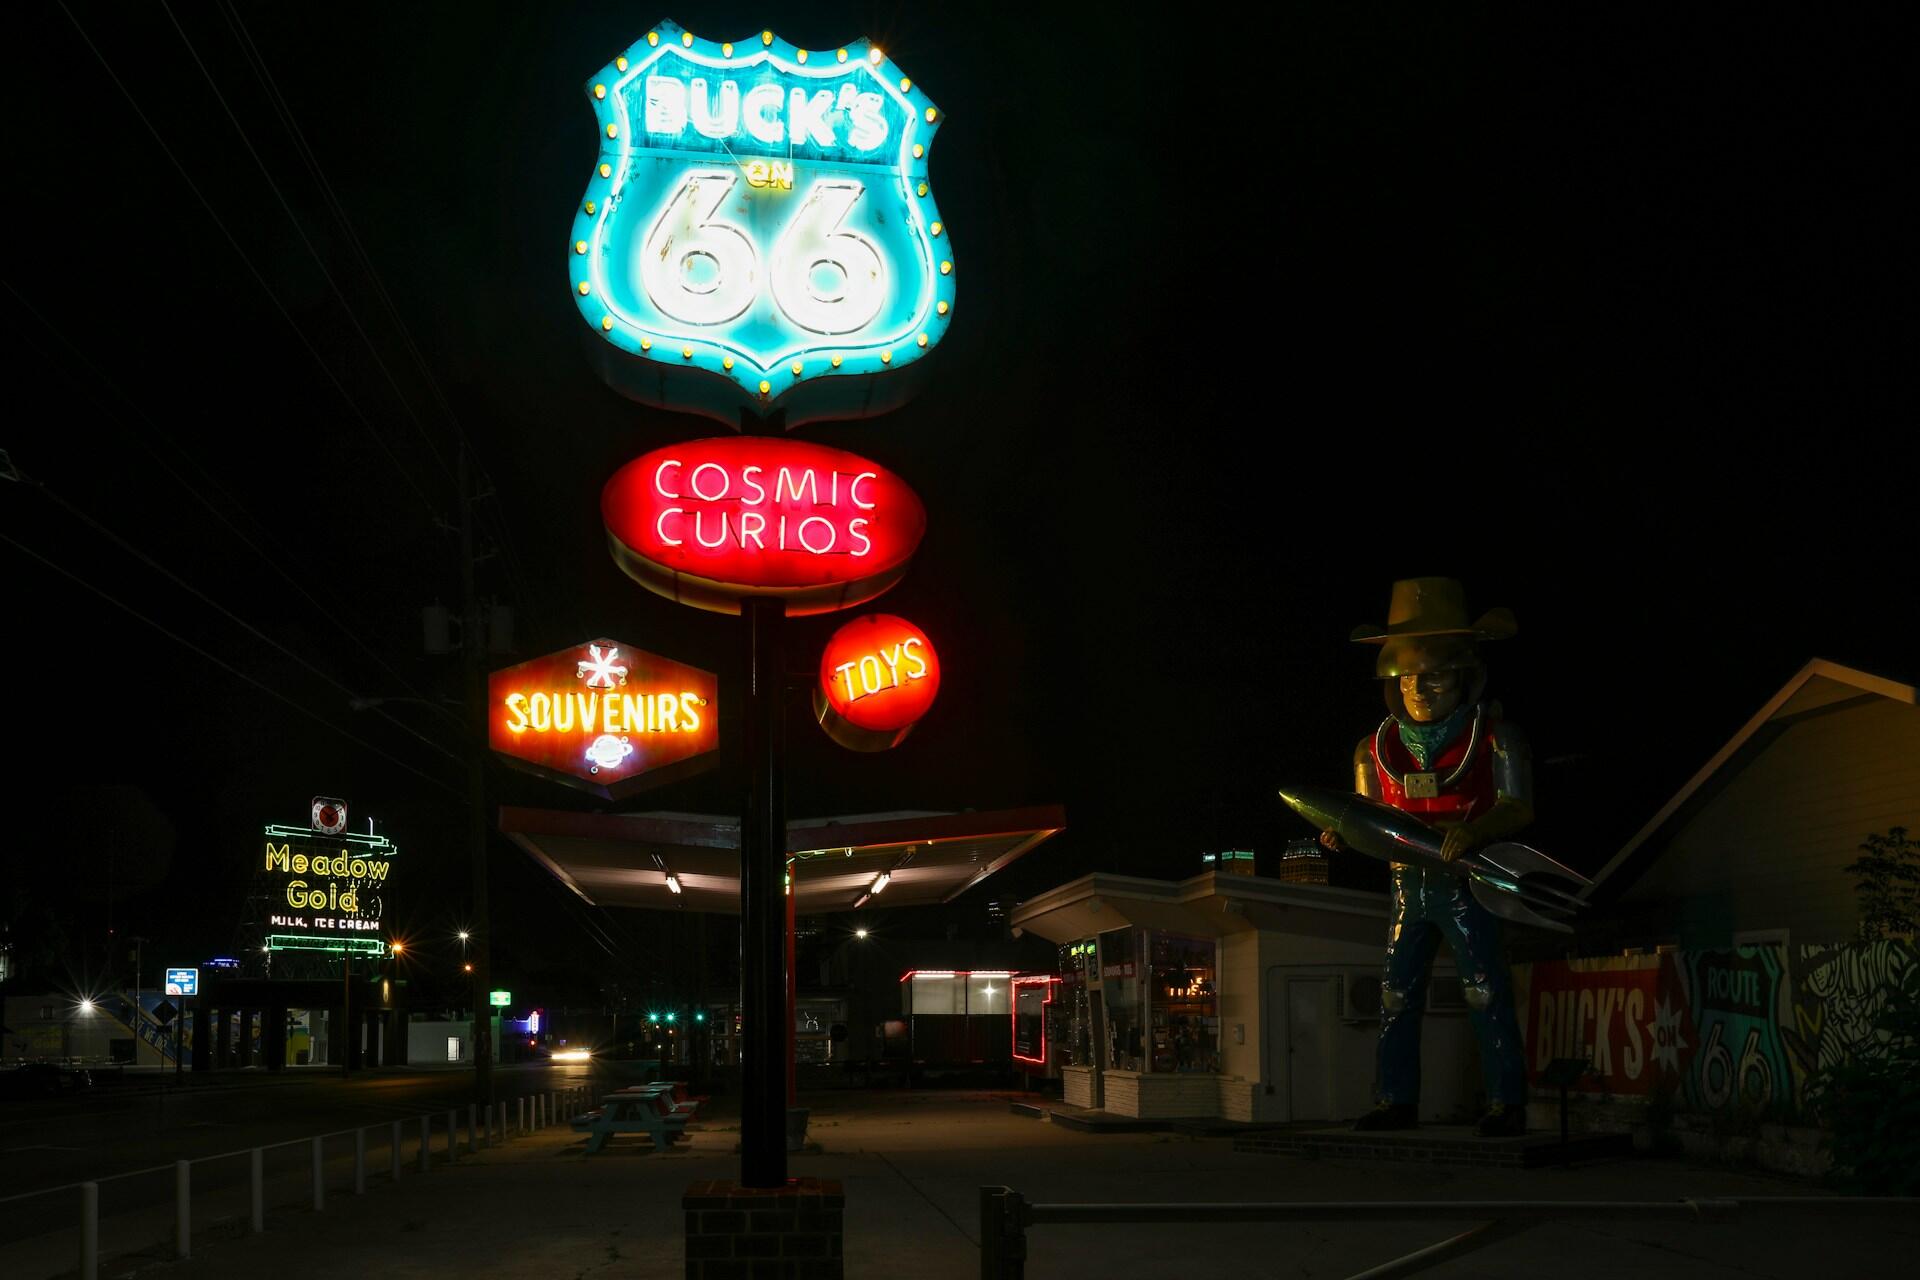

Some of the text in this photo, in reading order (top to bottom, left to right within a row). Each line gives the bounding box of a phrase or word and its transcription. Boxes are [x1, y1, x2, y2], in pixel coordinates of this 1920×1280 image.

[644, 75, 889, 151] BUCK'S
[746, 160, 794, 190] ON
[641, 169, 887, 336] 66
[655, 460, 877, 509] COSMIC
[656, 507, 872, 556] CURIOS
[835, 637, 930, 702] TOYS
[505, 691, 701, 734] SOUVENIRS
[265, 842, 390, 881] Meadow
[286, 879, 359, 913] Gold
[314, 917, 336, 929] ICE
[338, 918, 380, 930] CREAM
[1706, 965, 1762, 1009] ROUTE
[1535, 987, 1677, 1082] BUCK'S ON
[1701, 1022, 1773, 1110] 66
